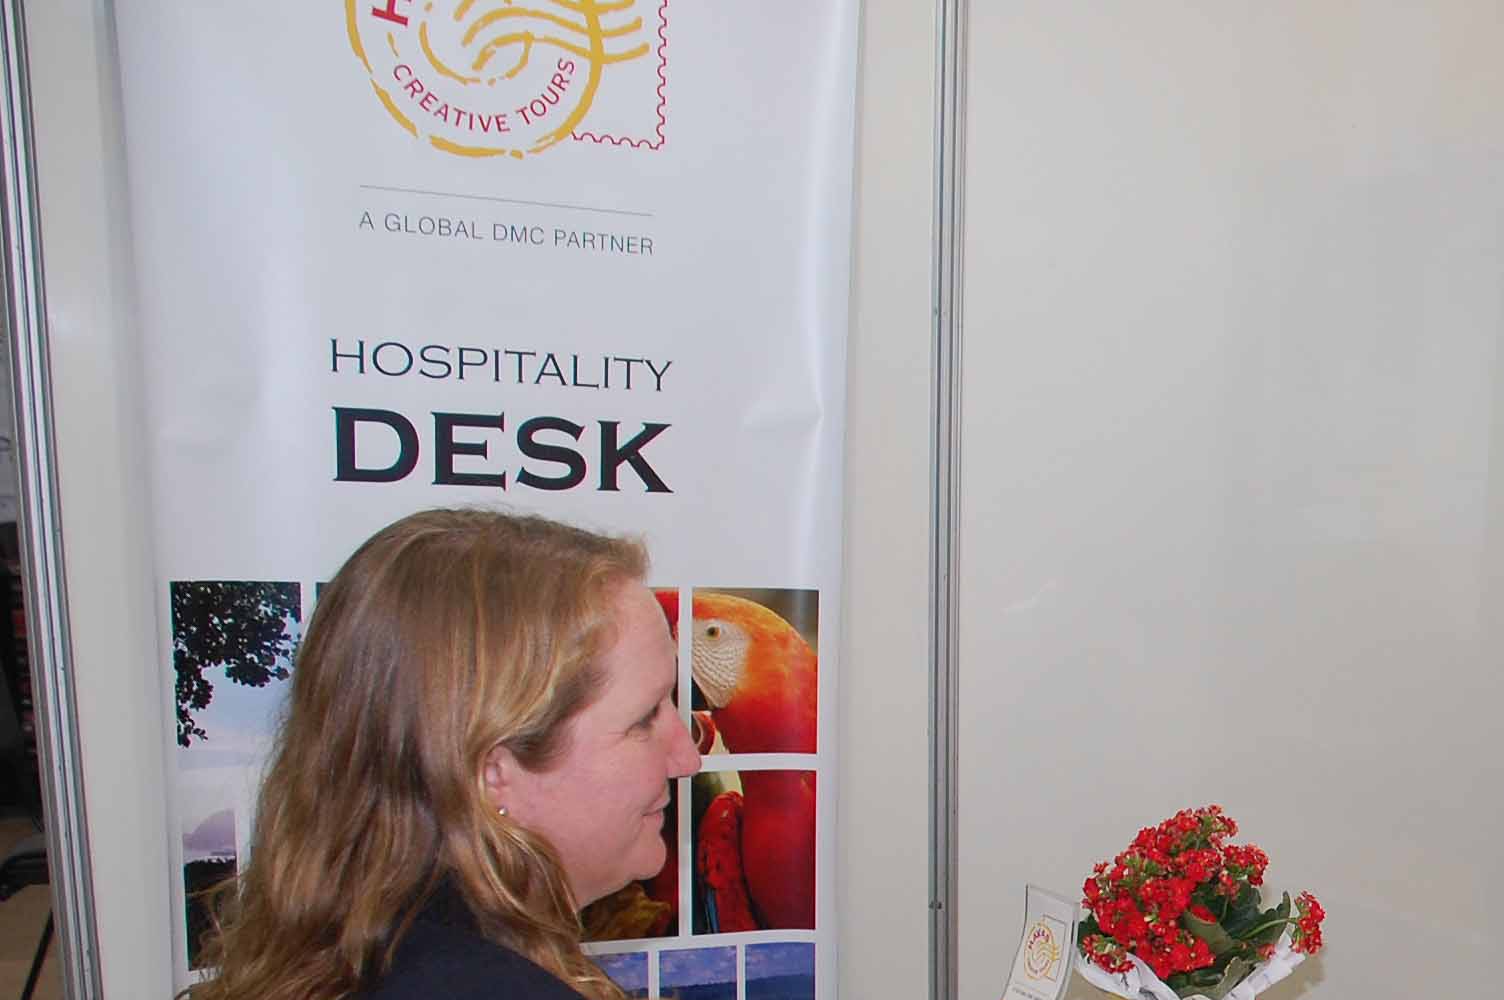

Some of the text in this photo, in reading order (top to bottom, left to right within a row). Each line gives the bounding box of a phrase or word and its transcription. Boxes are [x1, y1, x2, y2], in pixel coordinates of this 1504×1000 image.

[393, 57, 576, 133] CREATIVE TOURS
[359, 211, 654, 255] A GLOBAL DMC PARTNER
[330, 338, 673, 392] HOSPITALITY
[331, 405, 674, 494] DESK
